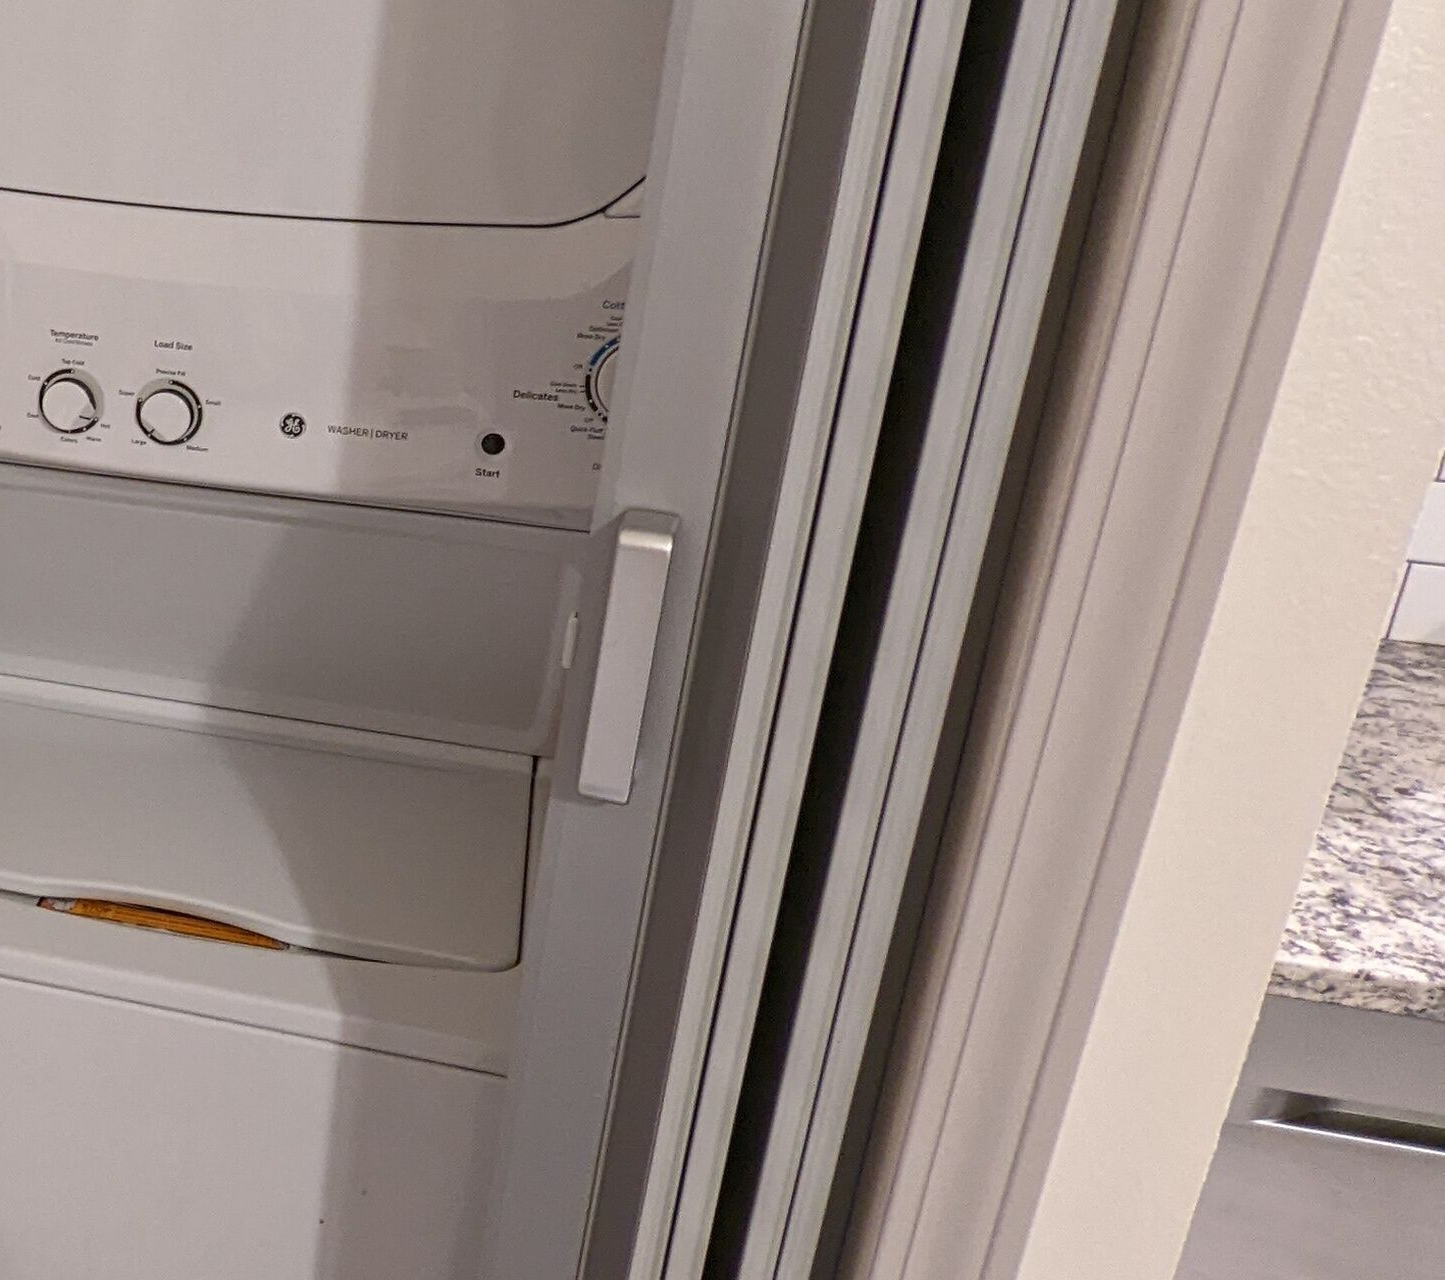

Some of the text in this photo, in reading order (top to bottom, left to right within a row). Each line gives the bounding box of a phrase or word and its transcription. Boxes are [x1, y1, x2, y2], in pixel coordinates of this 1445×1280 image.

[50, 329, 99, 343] Temperature
[154, 340, 193, 352] Load Size
[512, 390, 559, 402] Delicates
[327, 425, 408, 441] WASHER DRYER
[474, 467, 501, 479] Start
